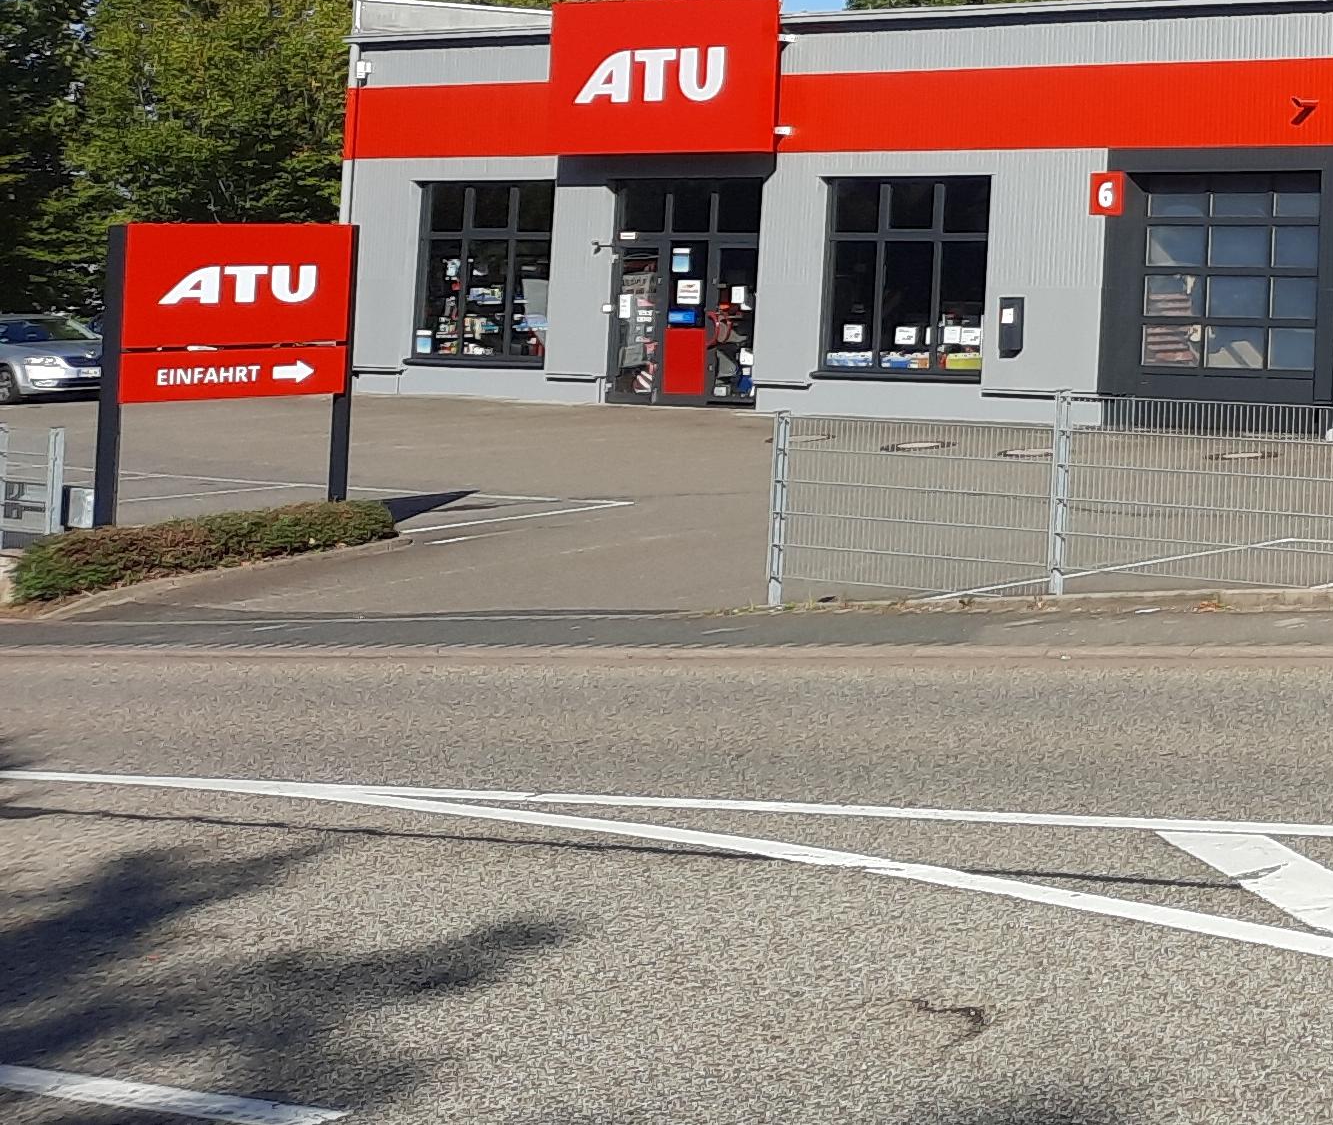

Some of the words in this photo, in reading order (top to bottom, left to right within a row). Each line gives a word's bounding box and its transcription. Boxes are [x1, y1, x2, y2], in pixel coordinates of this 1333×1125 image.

[574, 46, 727, 104] ATU
[1097, 181, 1115, 208] 6
[157, 264, 317, 305] ATU
[156, 365, 261, 386] EINFAHRT
